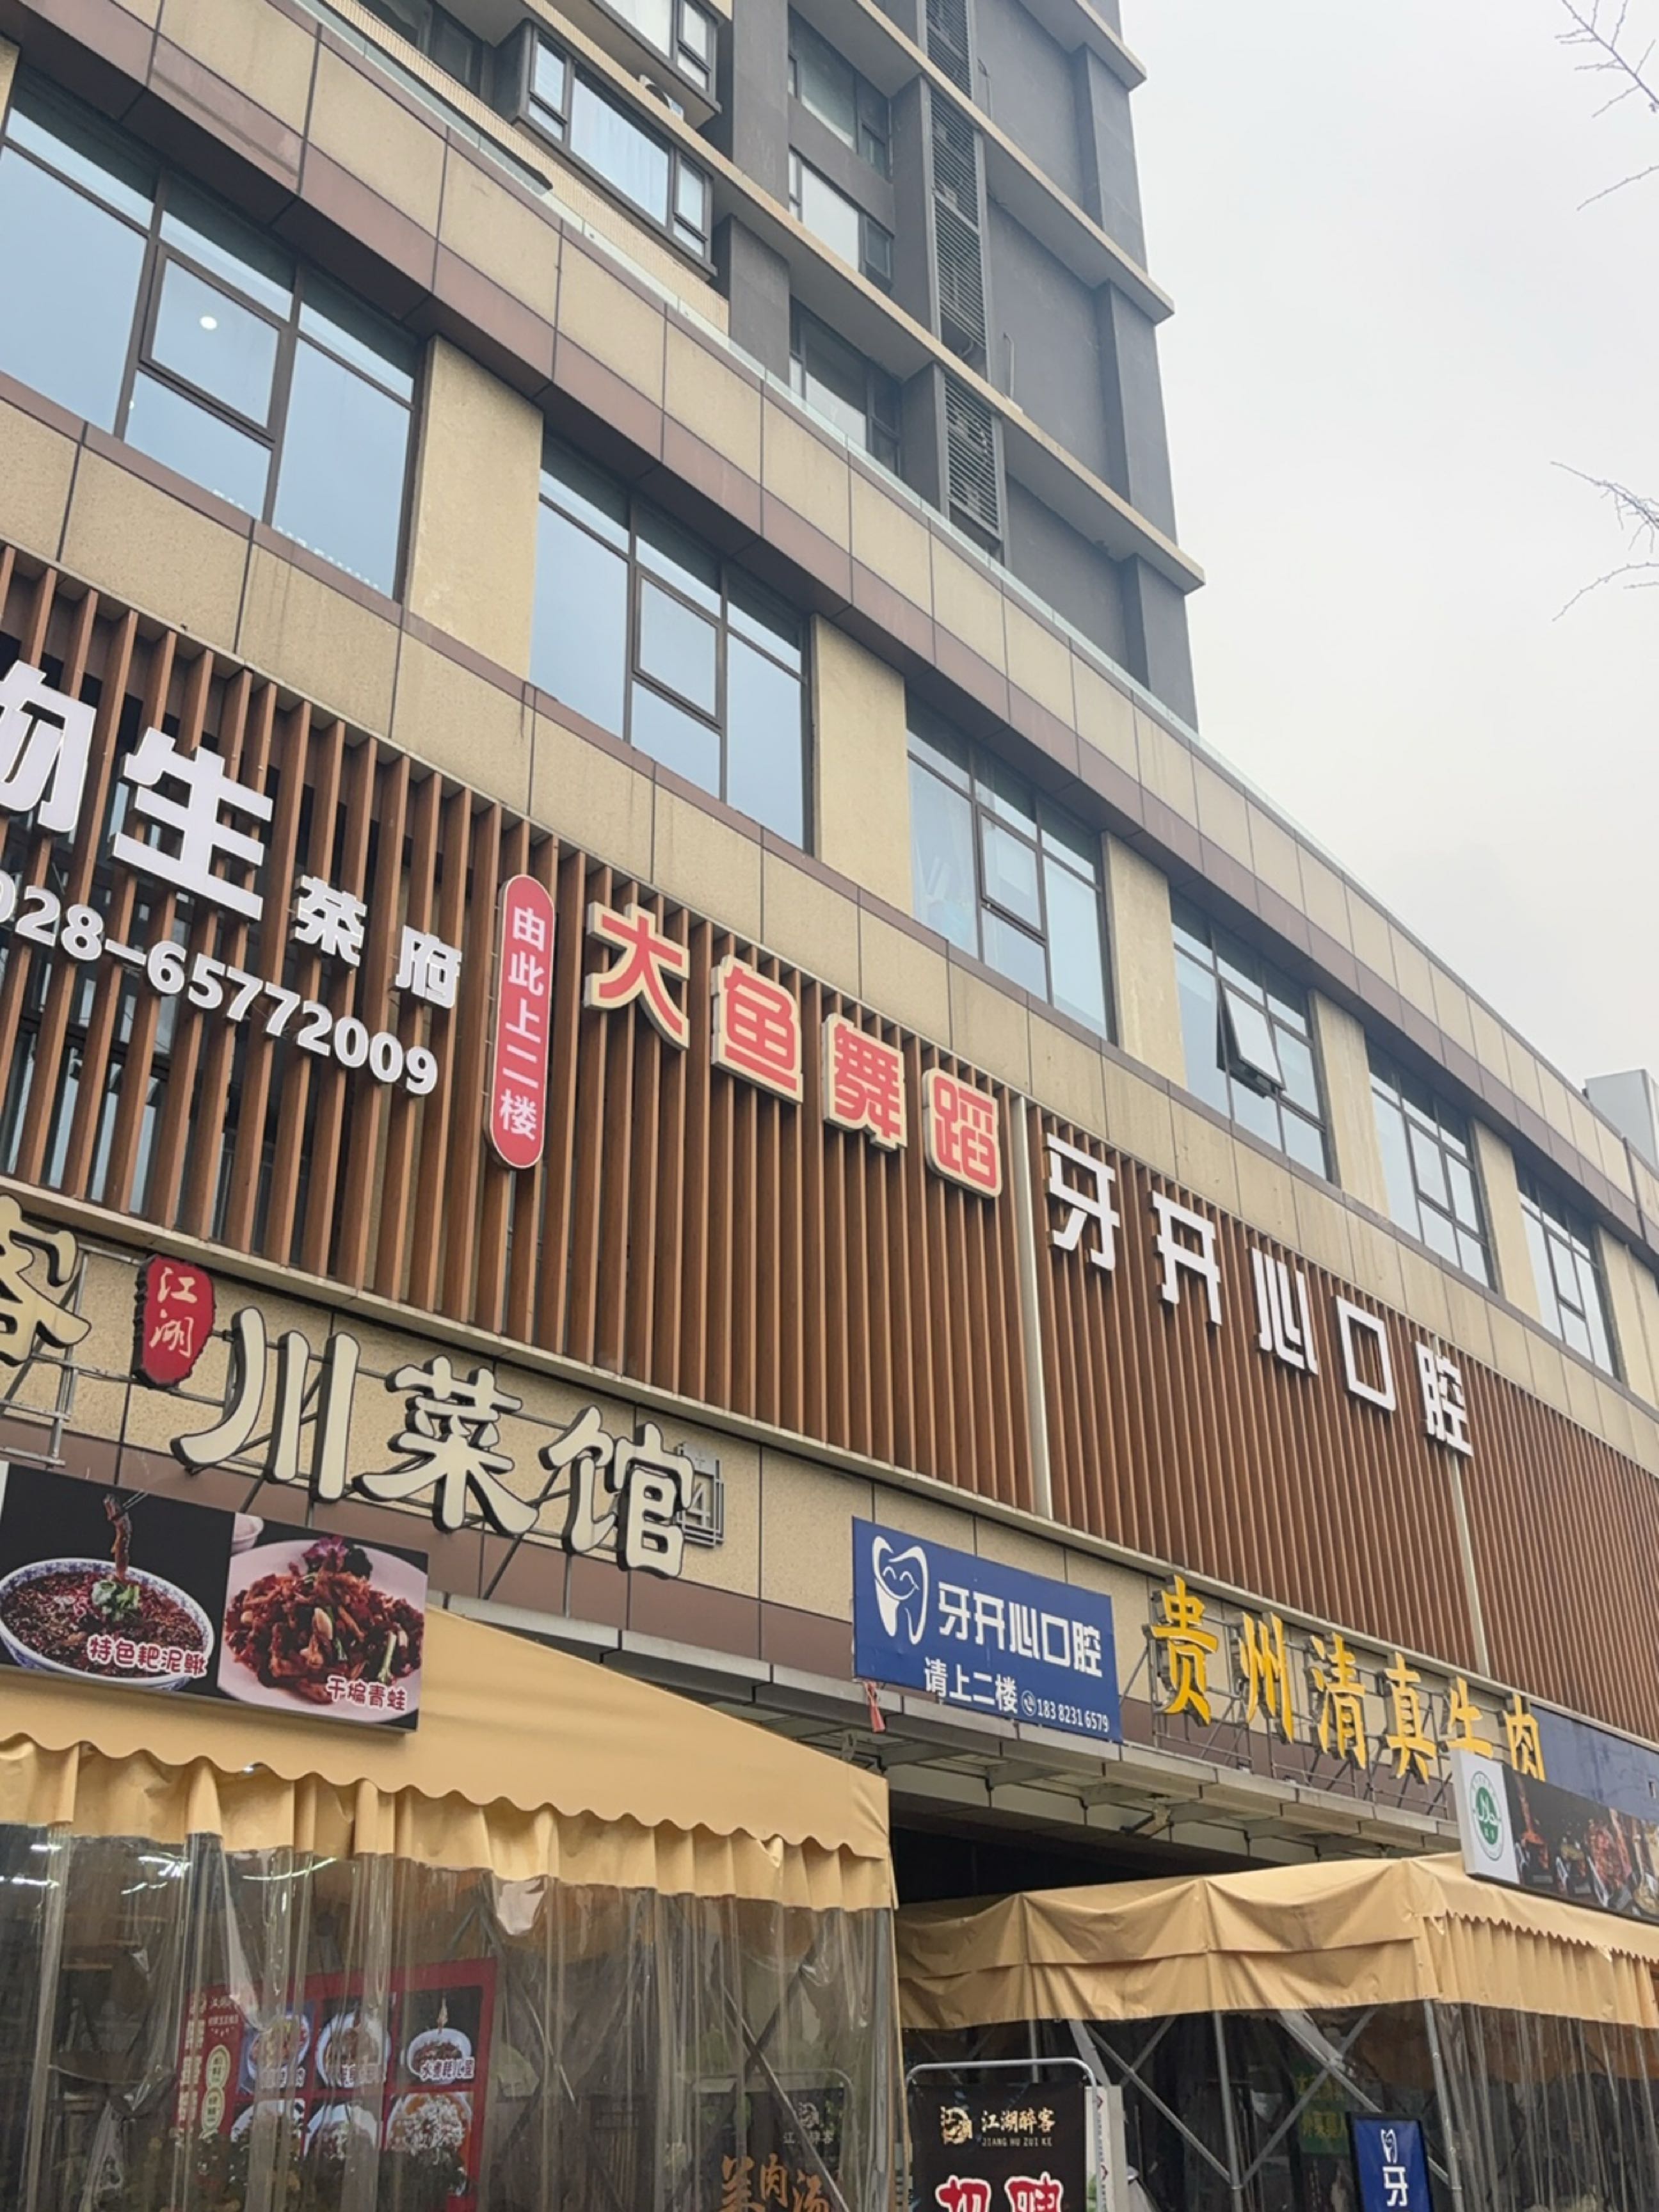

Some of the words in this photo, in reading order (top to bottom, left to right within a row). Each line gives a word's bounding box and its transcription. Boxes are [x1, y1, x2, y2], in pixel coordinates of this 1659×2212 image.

[499, 907, 545, 1141] 由此上二楼
[585, 901, 1002, 1199] 大鱼舞蹈
[149, 1267, 197, 1357] 江湖
[1046, 1132, 1472, 1457] 牙开心口腔
[173, 1307, 693, 1578] 川菜馆
[924, 1657, 1018, 1714] 请上二楼
[938, 1582, 1102, 1677] 牙开心口腔
